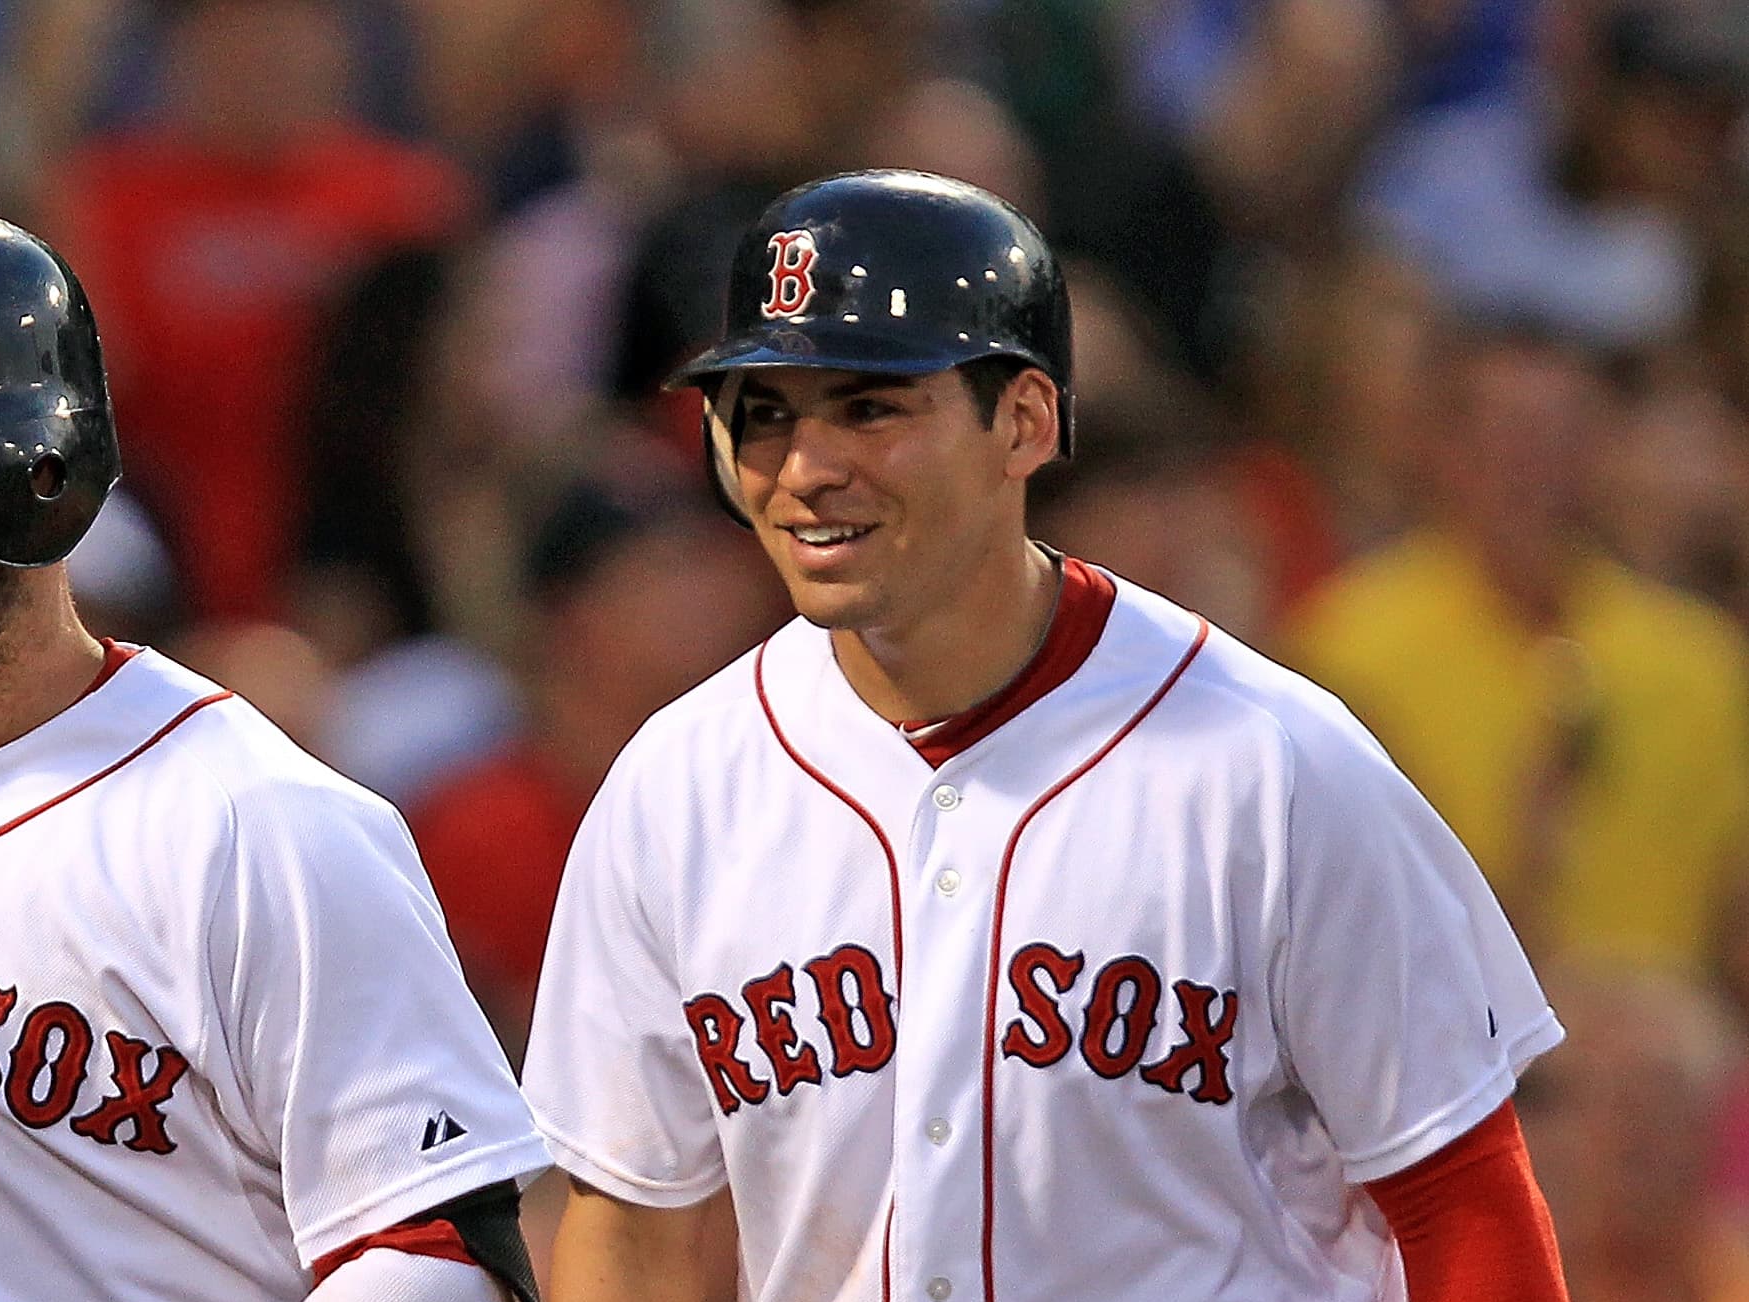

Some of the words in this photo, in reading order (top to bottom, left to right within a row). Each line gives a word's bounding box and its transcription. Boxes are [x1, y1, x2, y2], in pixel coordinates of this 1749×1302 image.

[761, 229, 819, 318] B
[683, 943, 896, 1116] RED
[1002, 942, 1239, 1105] SOX
